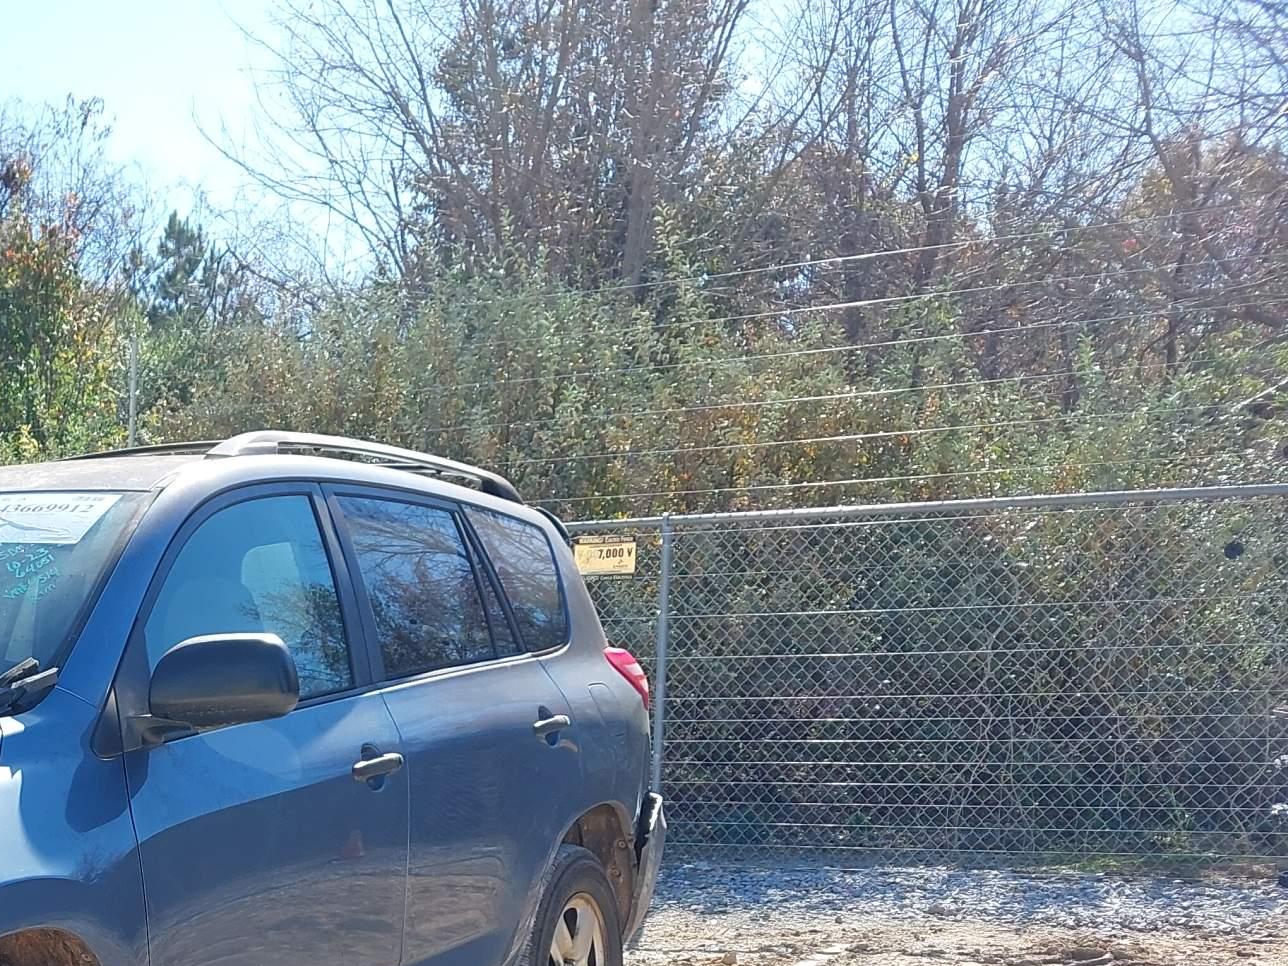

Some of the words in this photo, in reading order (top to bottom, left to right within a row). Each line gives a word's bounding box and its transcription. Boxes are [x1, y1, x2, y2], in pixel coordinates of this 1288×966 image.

[0, 503, 95, 513] 43669912
[598, 548, 624, 560] 7,000
[627, 547, 633, 557] V
